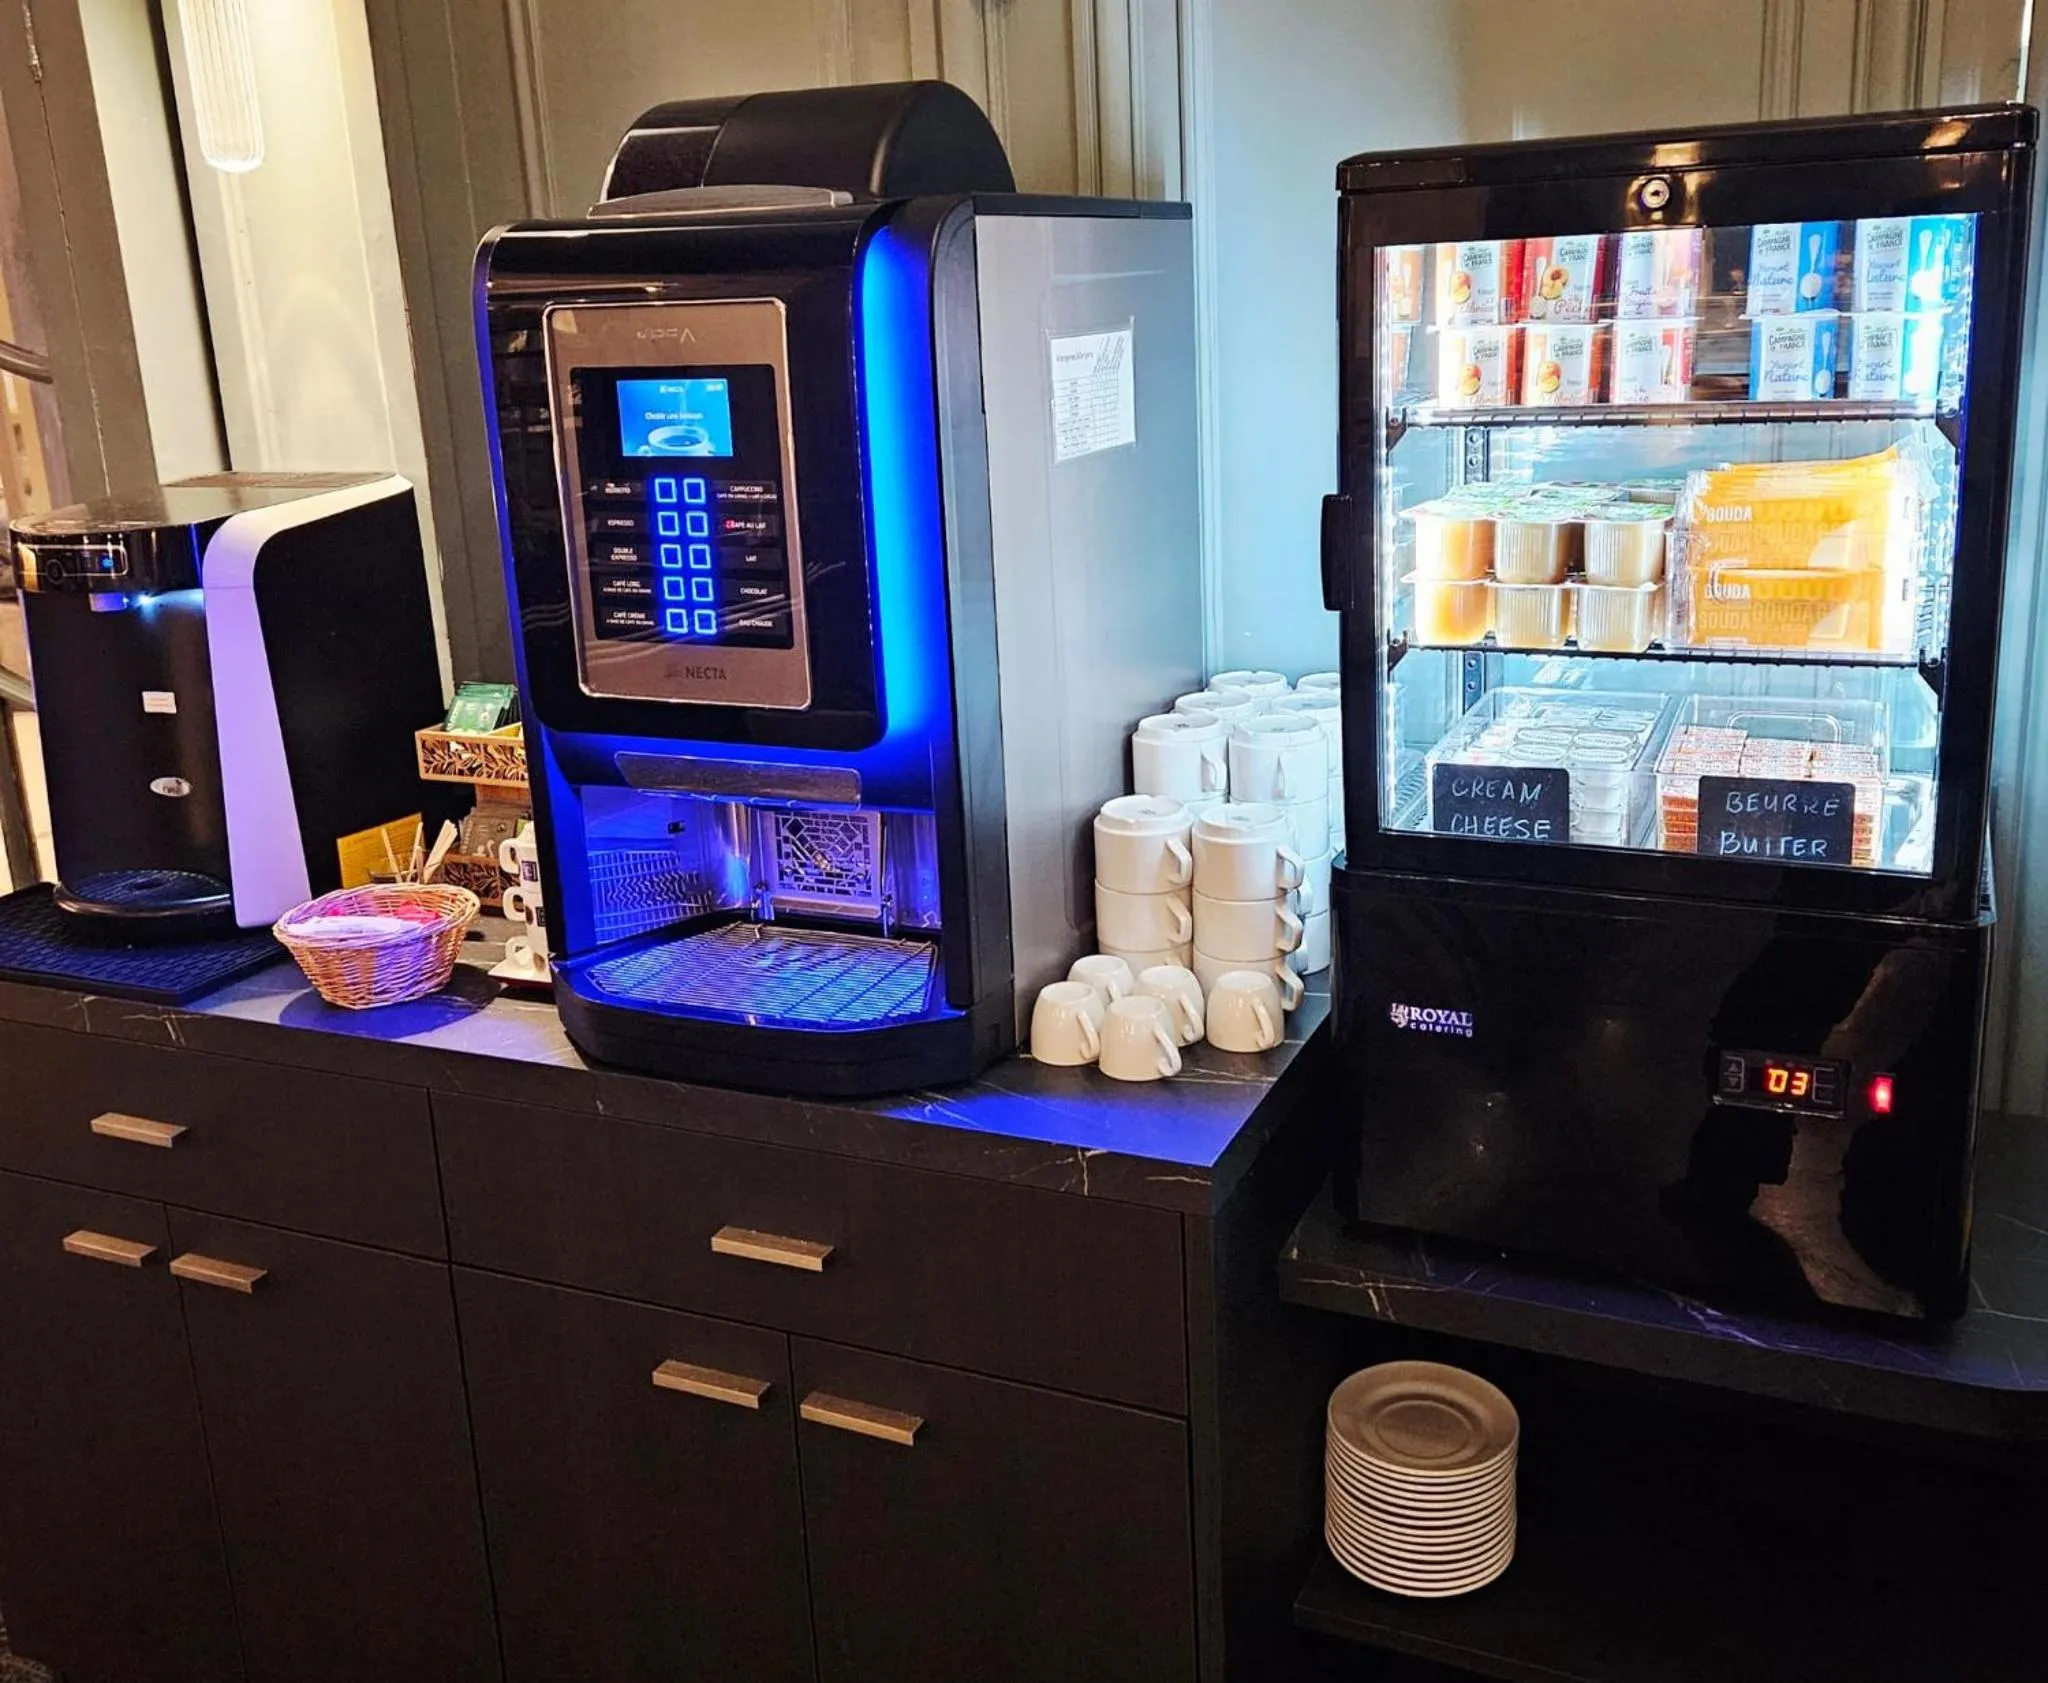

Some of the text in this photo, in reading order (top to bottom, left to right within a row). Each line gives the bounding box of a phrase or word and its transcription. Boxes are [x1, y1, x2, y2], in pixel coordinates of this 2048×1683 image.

[1707, 505, 1753, 522] GOUDA
[607, 519, 635, 527] ESPRESSO
[740, 587, 768, 595] CHOCOLAT
[1704, 583, 1750, 598] GOUDA
[685, 666, 727, 680] NECTA
[1452, 776, 1542, 803] CREAM
[1726, 792, 1840, 816] BEURRE
[1451, 813, 1551, 839] CHEESE
[1410, 1006, 1473, 1028] ROYAL
[1410, 1021, 1473, 1038] catering
[1767, 1067, 1809, 1096] 03
